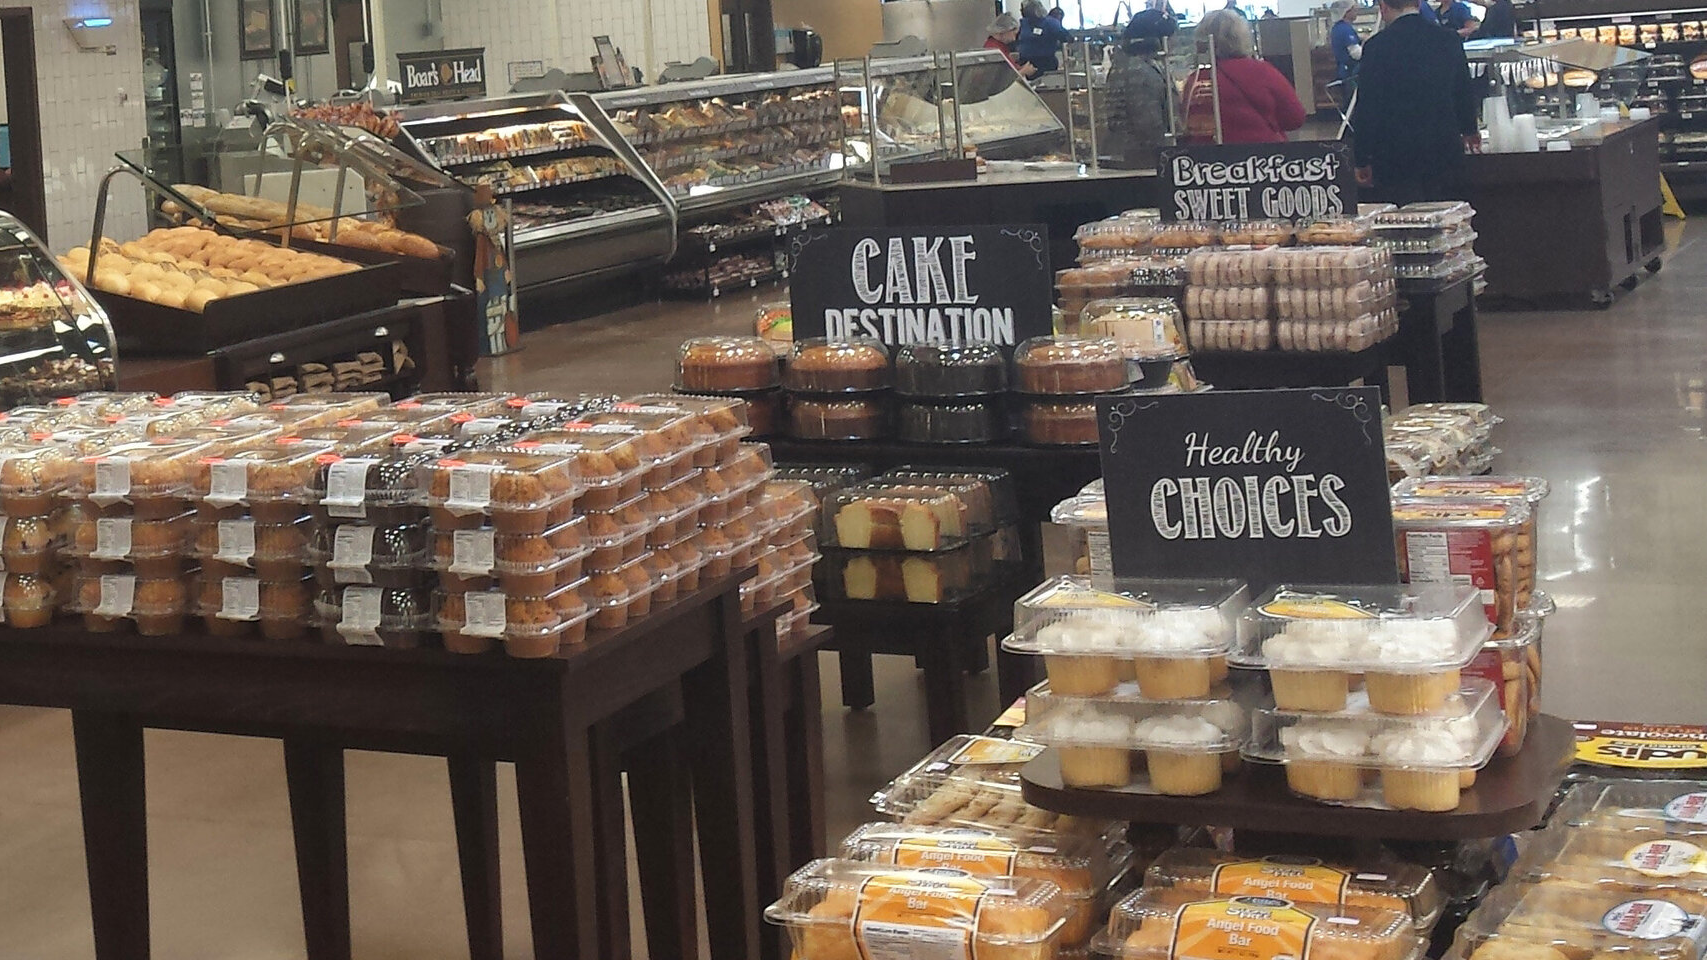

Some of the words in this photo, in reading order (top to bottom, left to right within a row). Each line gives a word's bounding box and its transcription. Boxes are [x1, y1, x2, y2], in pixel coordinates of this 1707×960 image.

[406, 62, 440, 88] Boar's
[452, 58, 482, 84] Head
[1172, 152, 1340, 187] Breakfast
[1173, 186, 1251, 221] SWEET
[1261, 184, 1343, 220] GOODS
[851, 234, 979, 305] CAKE
[824, 307, 1015, 347] DESTINATION
[1184, 429, 1306, 473] Healthy
[1150, 473, 1353, 540] CHOICES
[1600, 728, 1707, 741] hocolate
[920, 851, 954, 863] Angel
[1243, 876, 1280, 889] Angel
[1282, 878, 1314, 890] Food
[907, 898, 929, 909] Bar
[1206, 917, 1245, 932] Angel
[1247, 920, 1280, 936] Food
[1229, 933, 1252, 947] Bar
